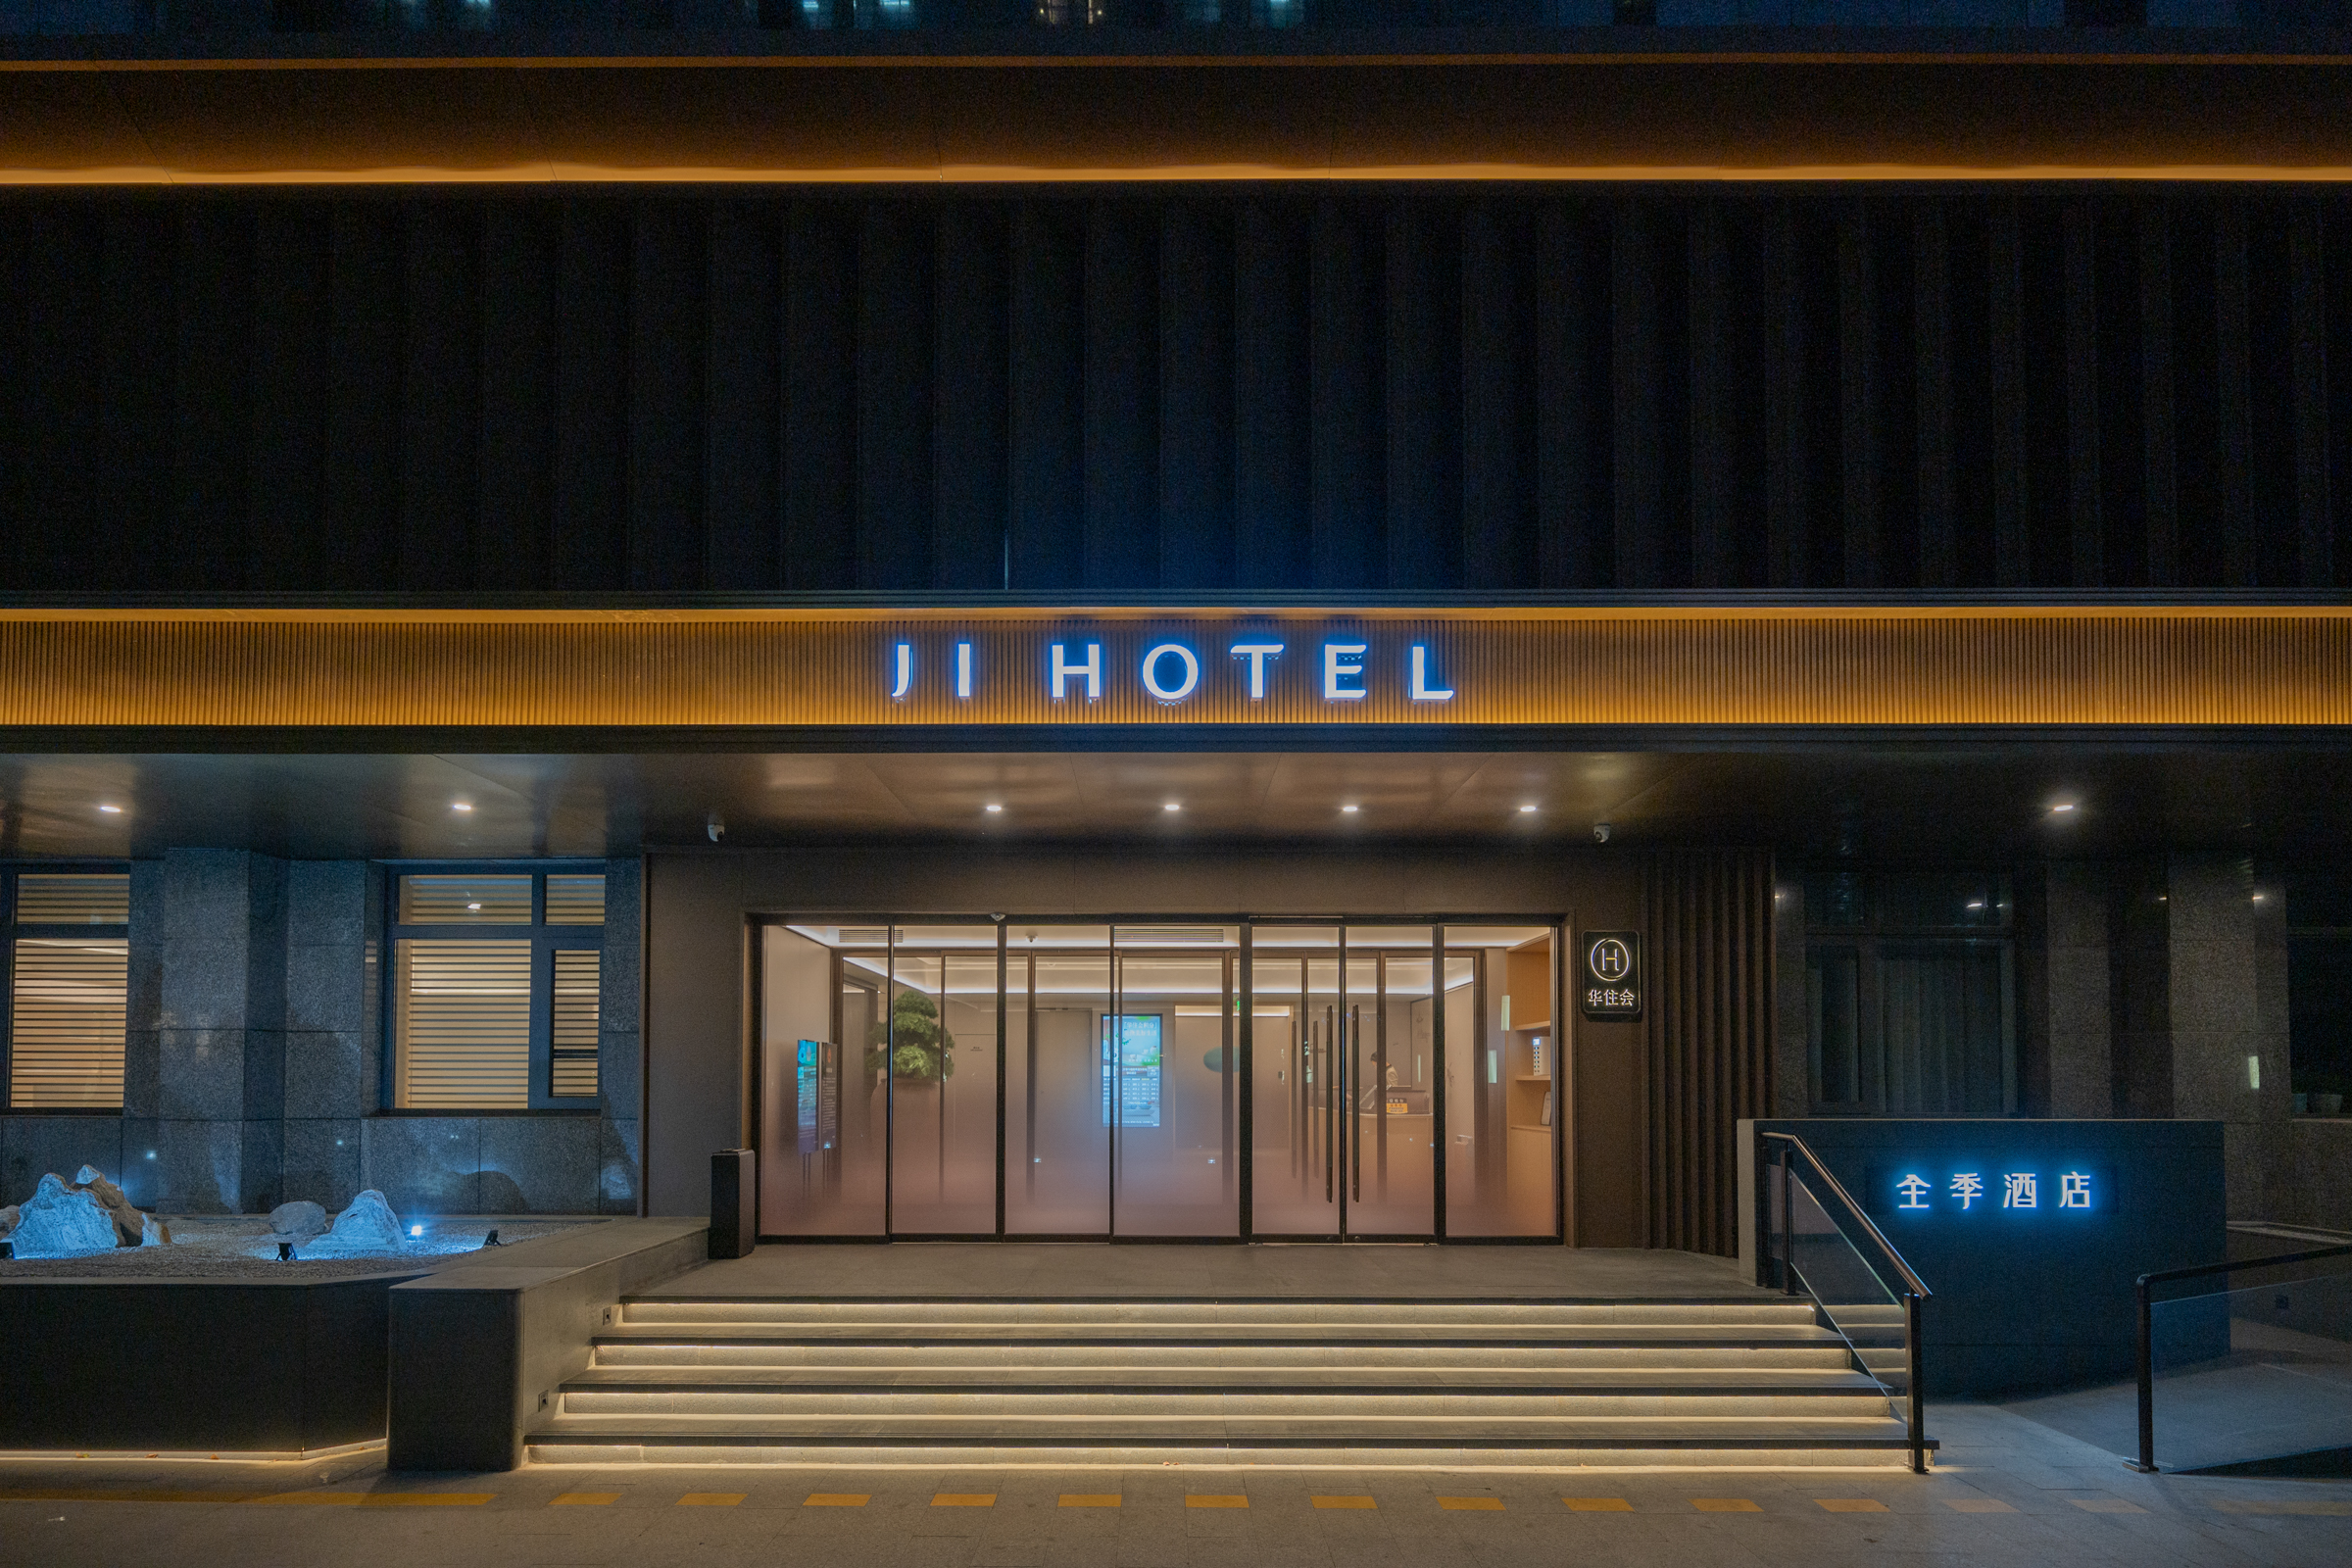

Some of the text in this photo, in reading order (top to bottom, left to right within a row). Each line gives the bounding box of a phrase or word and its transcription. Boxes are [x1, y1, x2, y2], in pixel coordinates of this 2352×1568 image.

[891, 643, 1455, 701] JI HOTEL
[1588, 988, 1636, 1007] 华住会
[1895, 1170, 2091, 1210] 全季酒店
